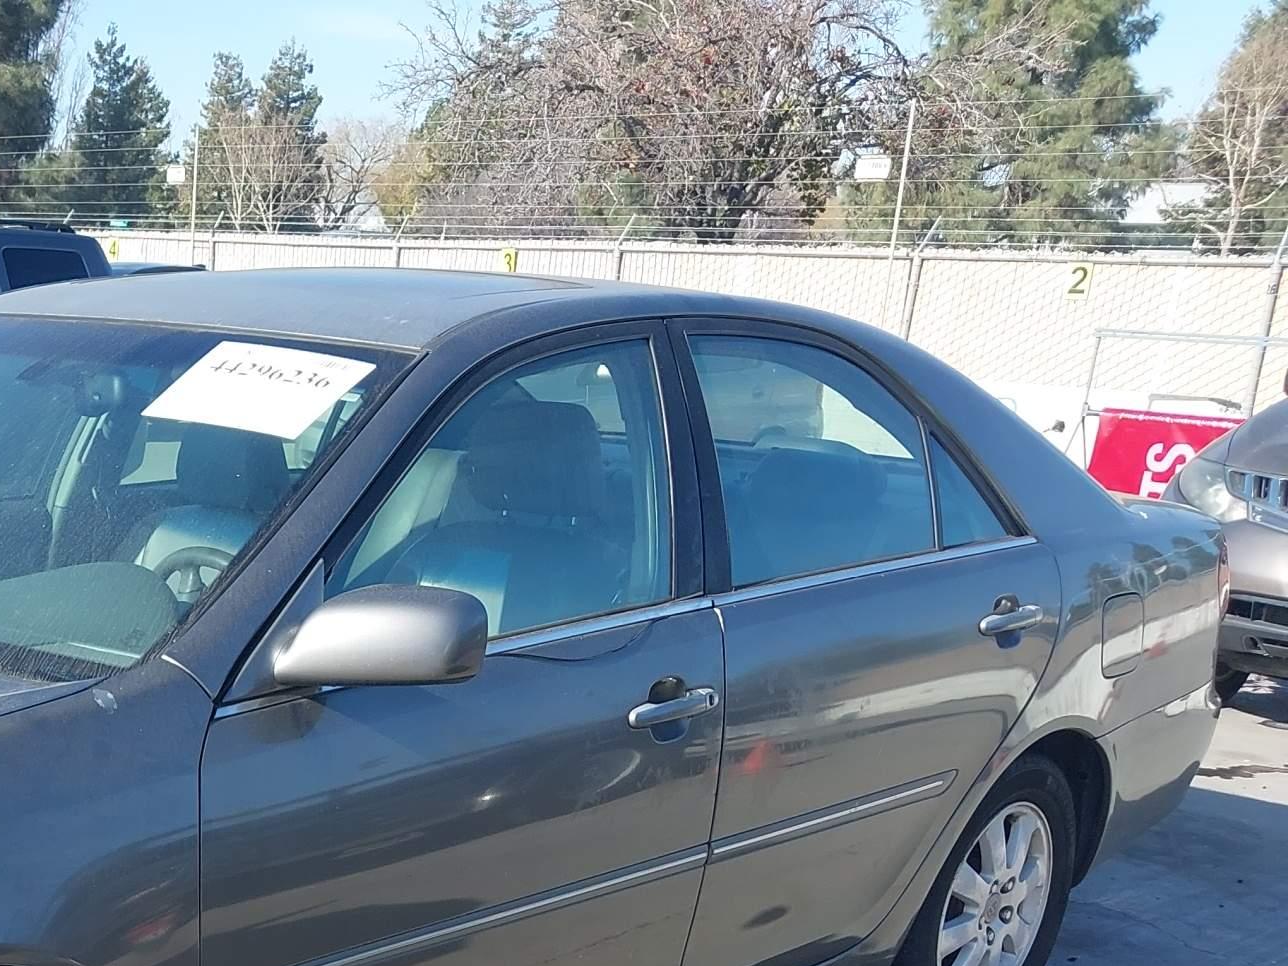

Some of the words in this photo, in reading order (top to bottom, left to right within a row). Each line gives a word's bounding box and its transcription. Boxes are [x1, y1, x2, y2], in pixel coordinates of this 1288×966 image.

[109, 240, 116, 258] 4
[504, 253, 512, 272] 3
[1067, 266, 1088, 294] 2
[210, 359, 331, 389] 44296236
